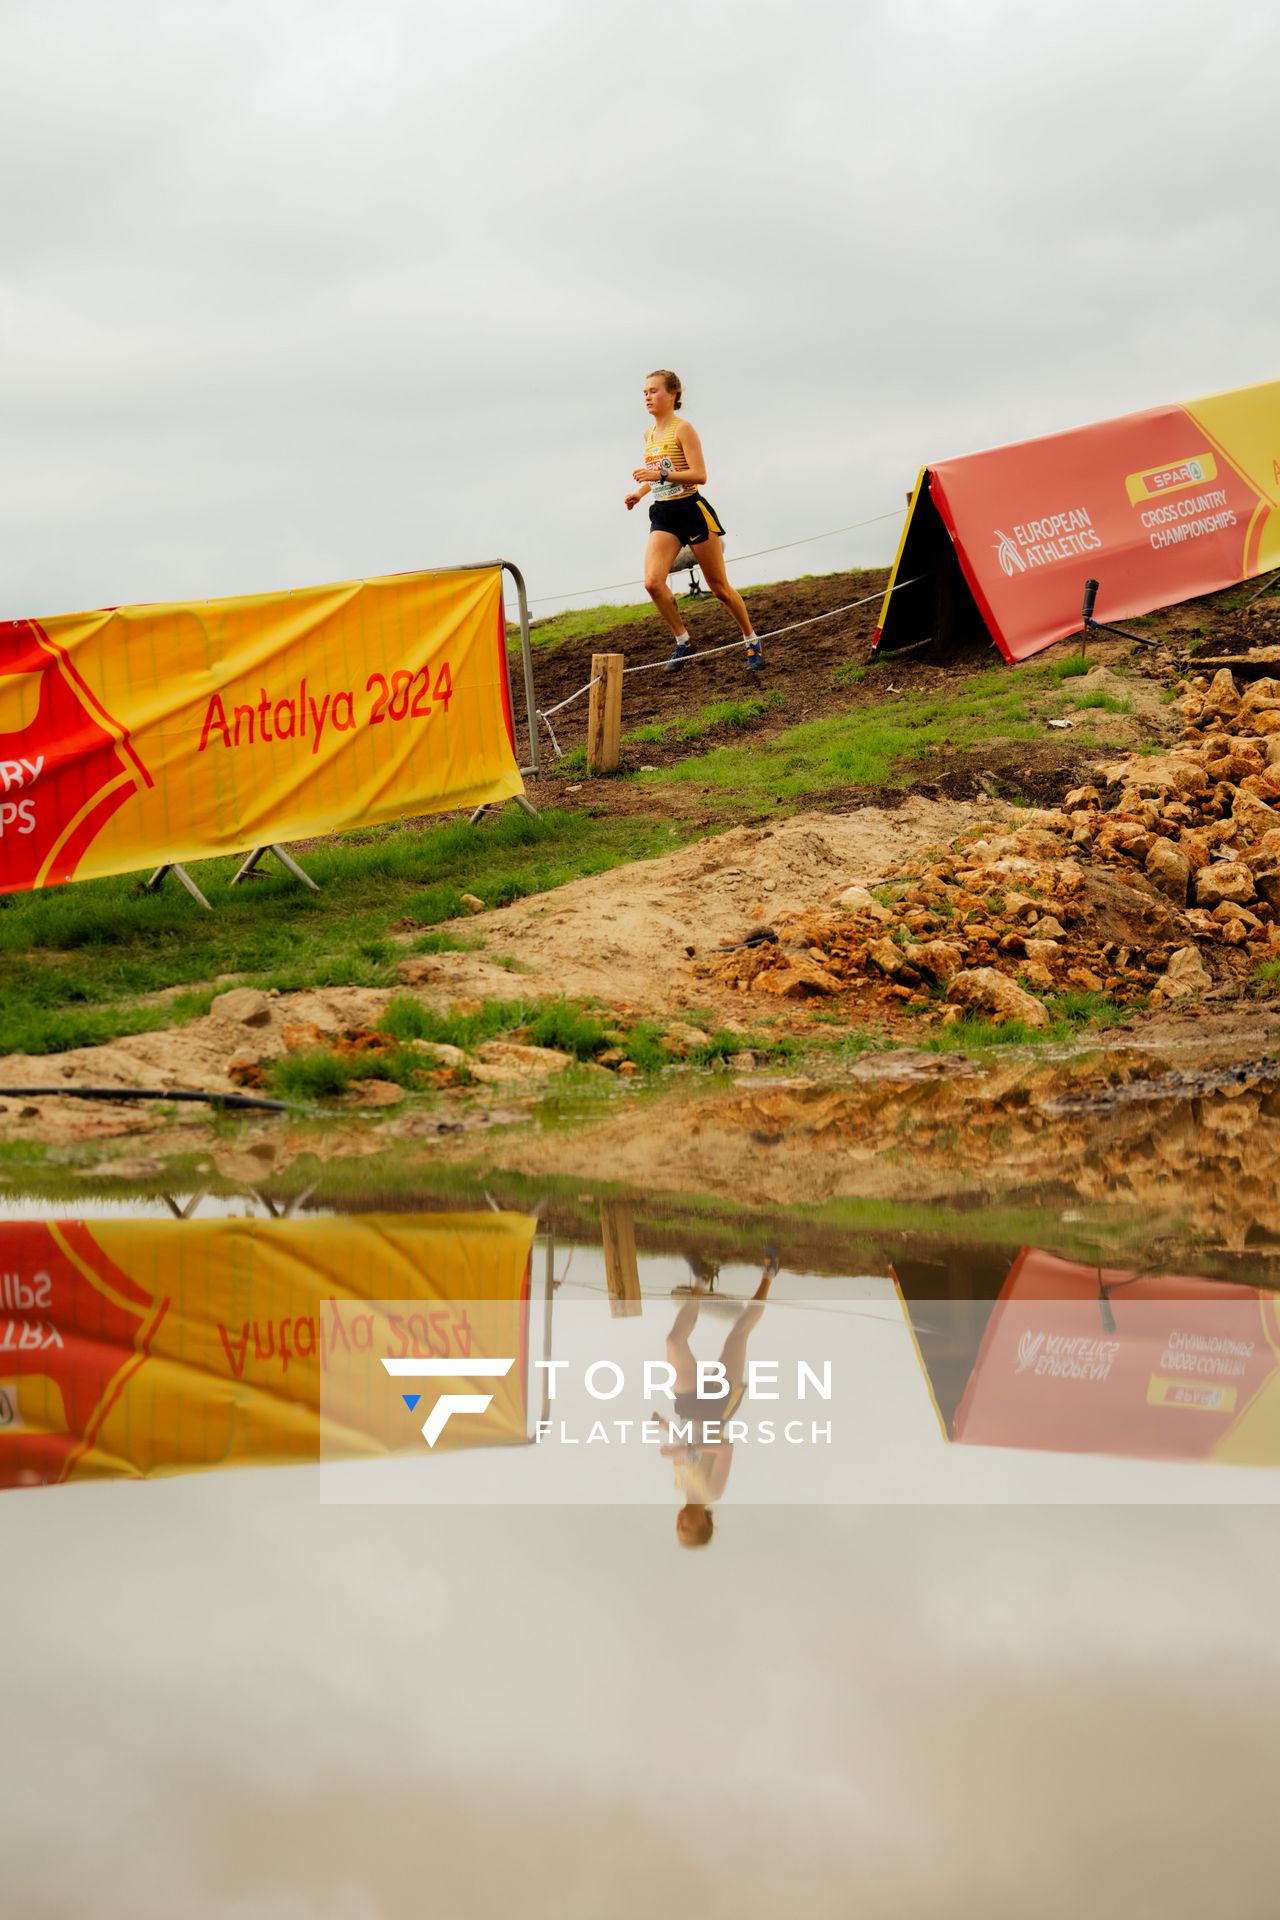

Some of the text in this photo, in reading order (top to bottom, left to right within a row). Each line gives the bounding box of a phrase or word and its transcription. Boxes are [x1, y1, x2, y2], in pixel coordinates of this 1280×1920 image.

[1153, 467, 1191, 488] SPAR
[1013, 507, 1092, 546] EUROPEAN
[1140, 489, 1227, 529] CROSS COUNTRY
[1025, 529, 1102, 568] ATHLETICS
[1150, 509, 1237, 550] CHAMPIONSHIPS
[198, 661, 453, 754] Antalya 2024
